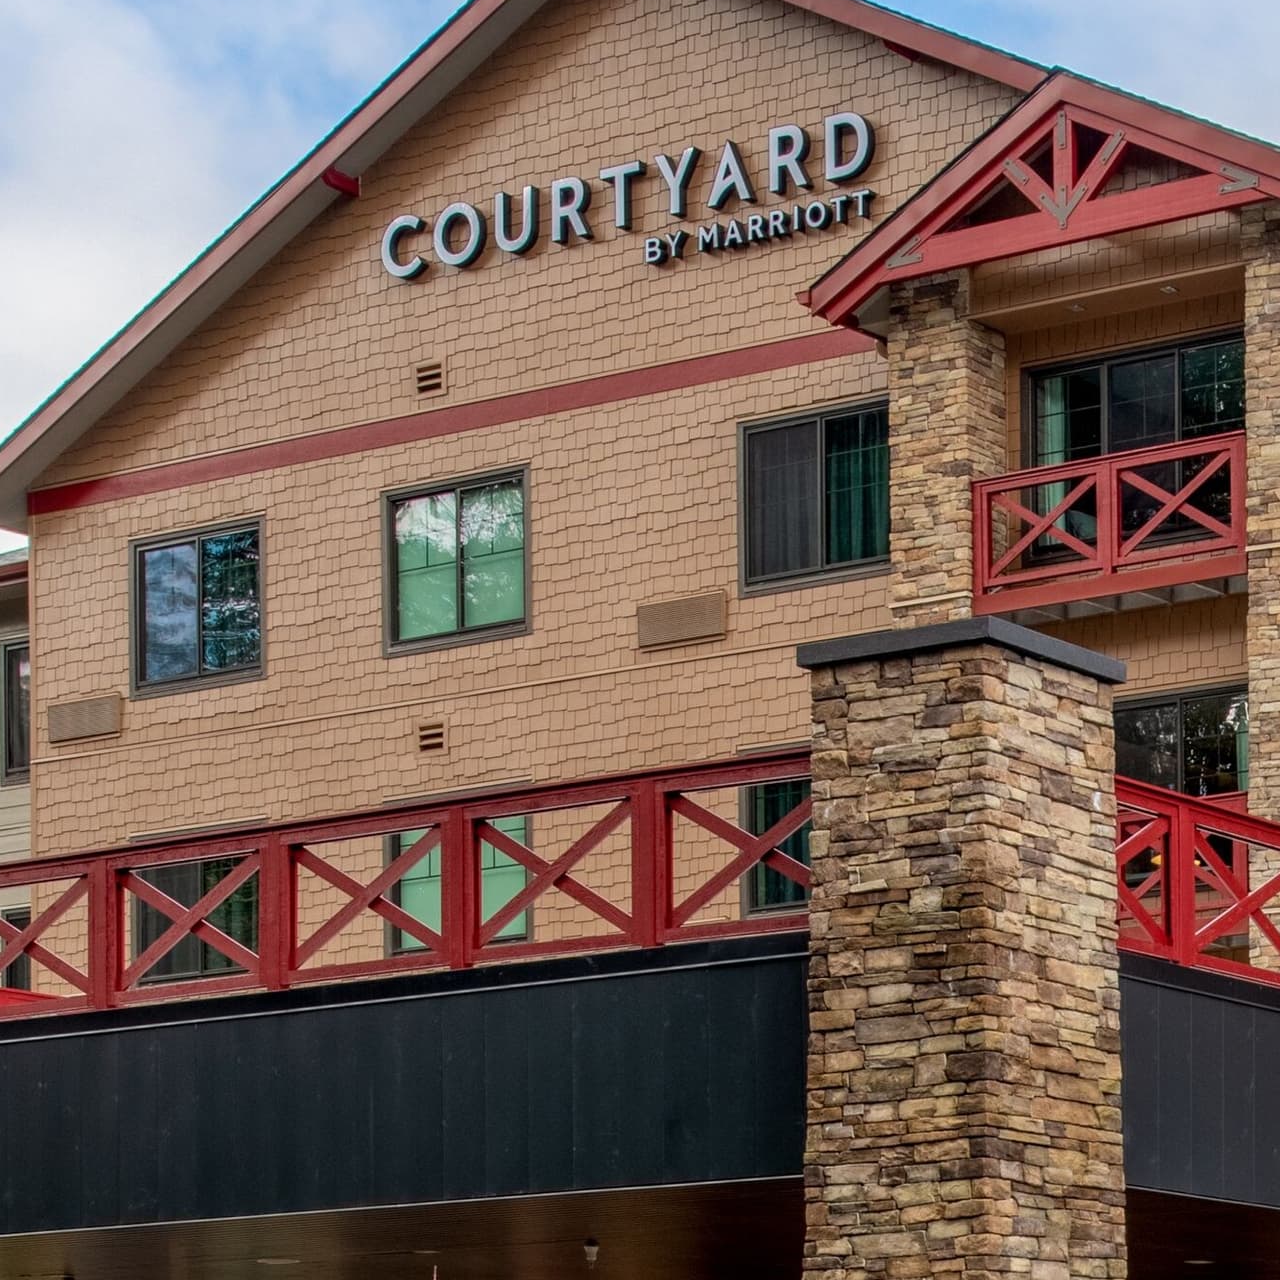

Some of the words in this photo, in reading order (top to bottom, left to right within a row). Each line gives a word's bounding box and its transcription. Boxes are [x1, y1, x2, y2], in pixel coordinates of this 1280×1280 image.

[381, 111, 876, 280] COURTYARD
[644, 229, 689, 265] BY
[698, 188, 876, 253] MARRIOTT
